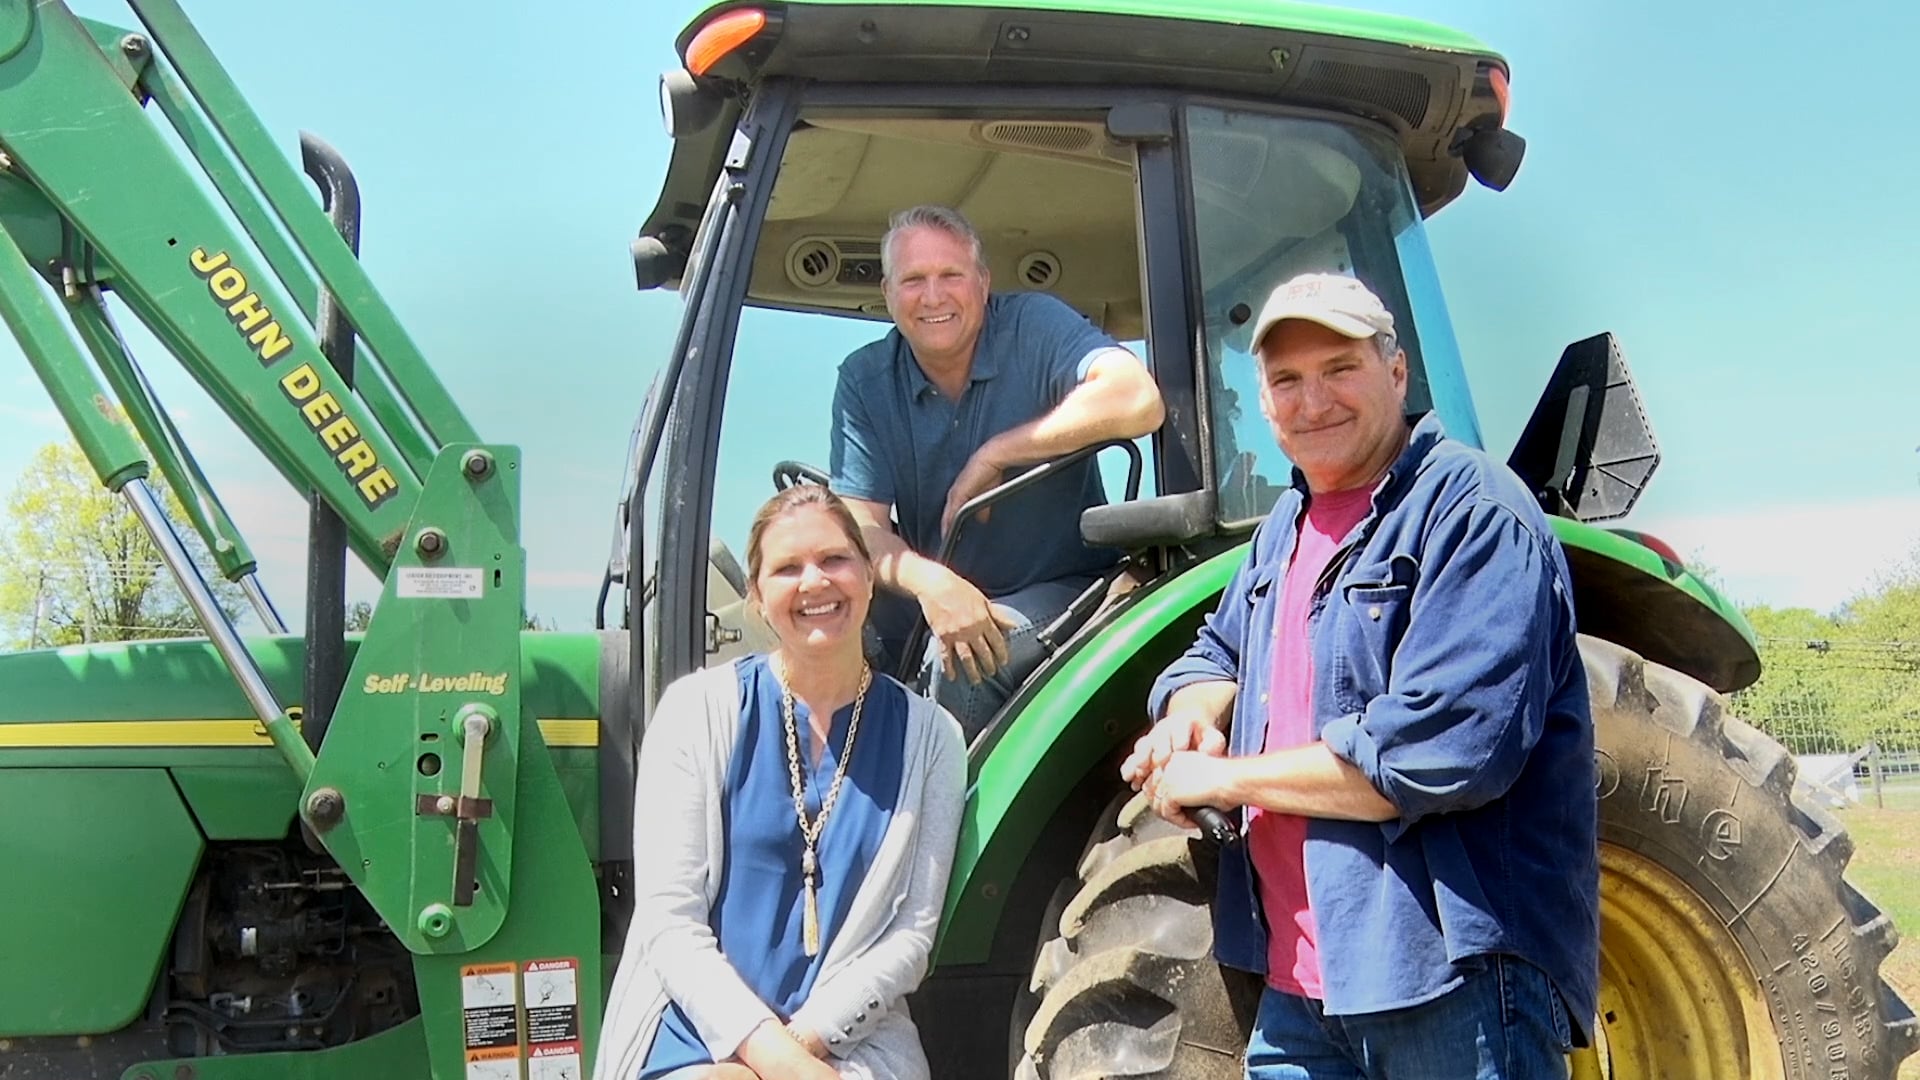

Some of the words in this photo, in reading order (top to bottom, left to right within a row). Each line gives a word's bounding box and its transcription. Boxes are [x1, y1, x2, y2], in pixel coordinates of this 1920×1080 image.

[190, 247, 293, 366] JOHN
[279, 362, 398, 511] DEERE
[538, 961, 570, 970] DANGER
[543, 1046, 575, 1056] DANGER
